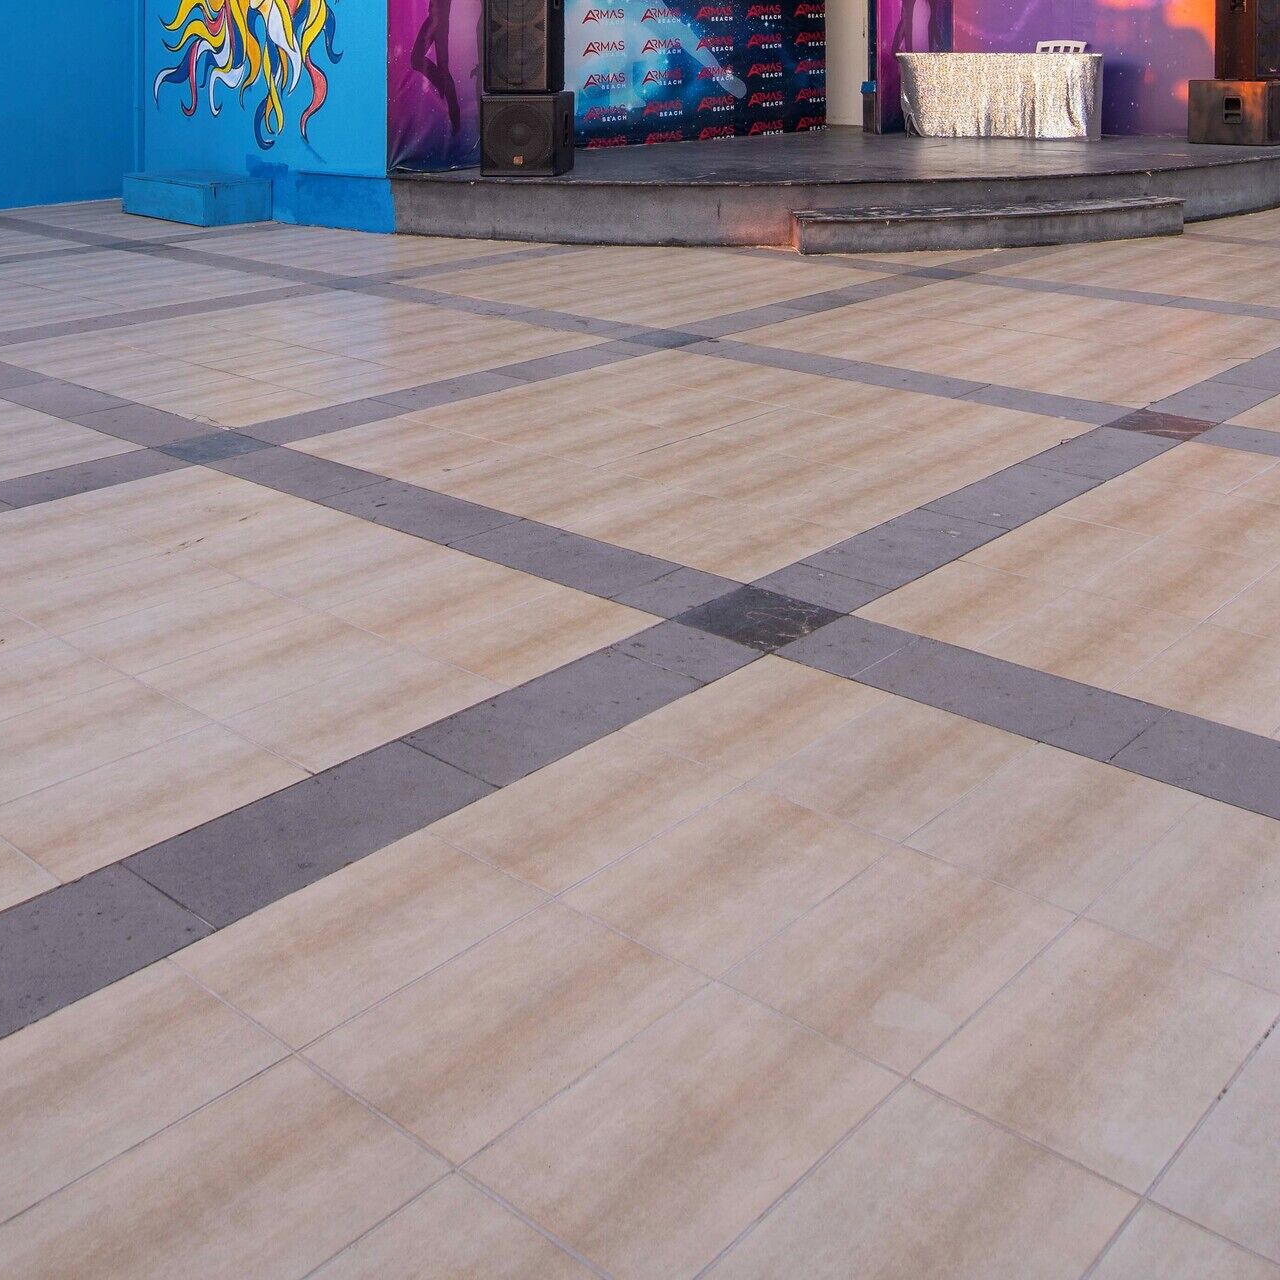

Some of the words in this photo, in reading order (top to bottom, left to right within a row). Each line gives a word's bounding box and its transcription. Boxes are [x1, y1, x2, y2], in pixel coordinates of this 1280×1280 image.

[582, 9, 624, 24] ARMAS
[641, 8, 680, 22] ARMAS
[583, 41, 625, 56] ARMAS
[641, 39, 680, 54] ARMAS
[748, 63, 782, 78] ARMAS
[583, 73, 625, 89] ARMAS
[748, 91, 783, 107] ARMAS
[748, 120, 783, 136] ARMAS
